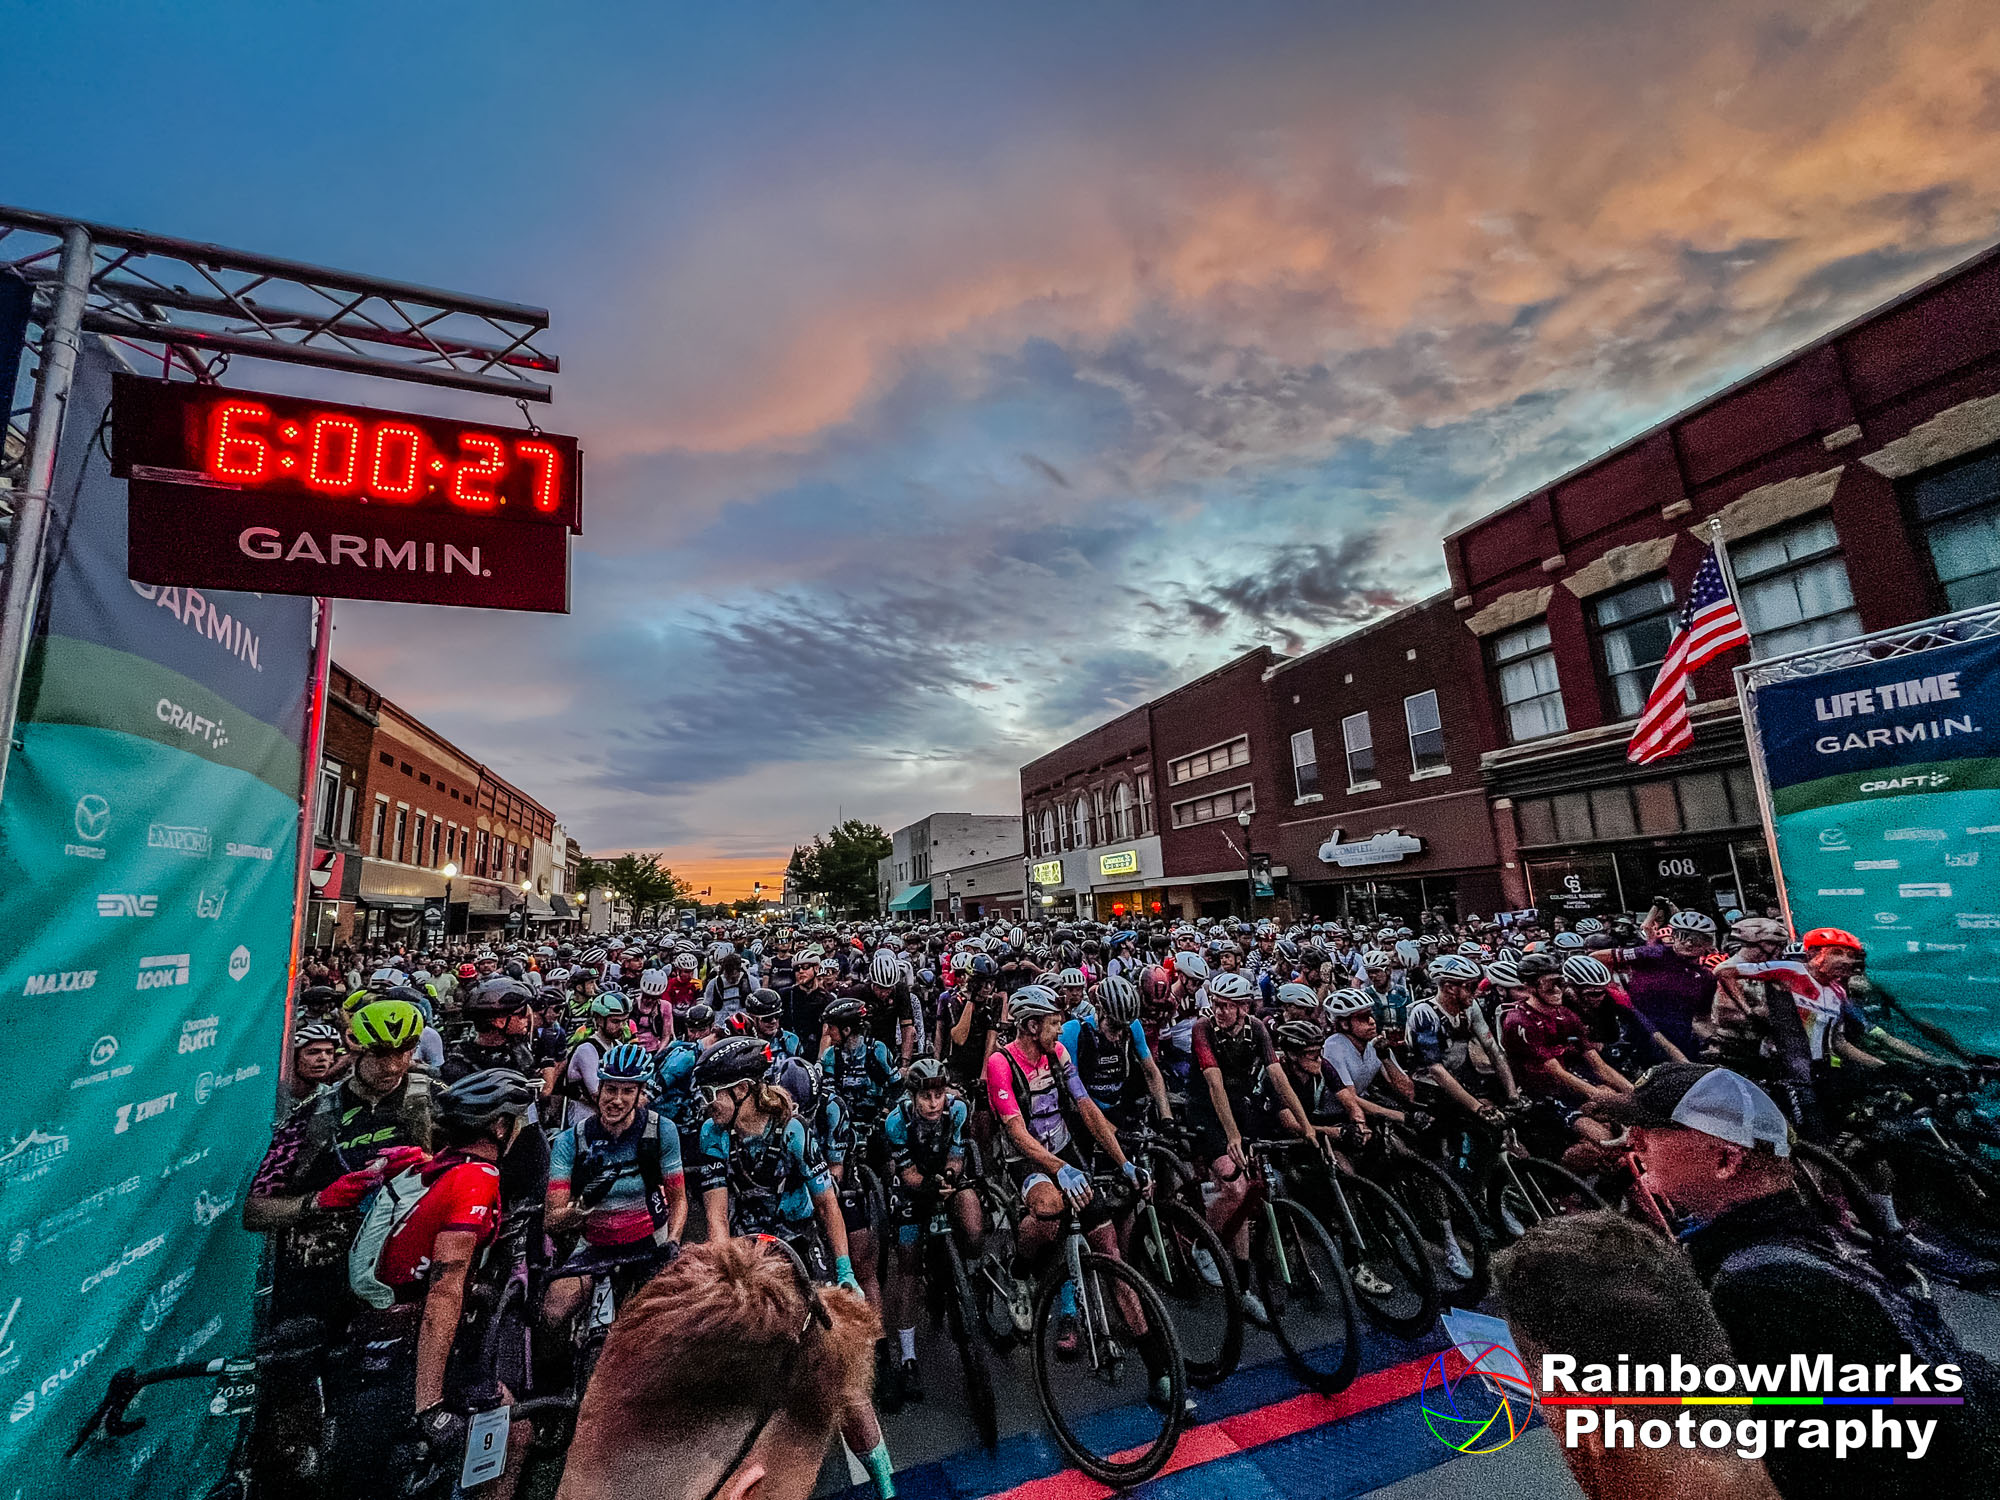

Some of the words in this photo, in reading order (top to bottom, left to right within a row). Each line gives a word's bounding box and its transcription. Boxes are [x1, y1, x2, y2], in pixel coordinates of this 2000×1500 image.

[212, 402, 560, 510] 6:00:27
[238, 526, 483, 576] GARMIN
[1815, 688, 1875, 721] LIFE
[1875, 672, 1961, 710] TIME
[156, 698, 216, 740] CRAFT
[1815, 714, 1974, 754] GARMIN
[1859, 775, 1929, 793] CRAFT
[1658, 858, 1696, 877] 608
[136, 968, 176, 991] LOOK
[483, 1432, 494, 1451] 9
